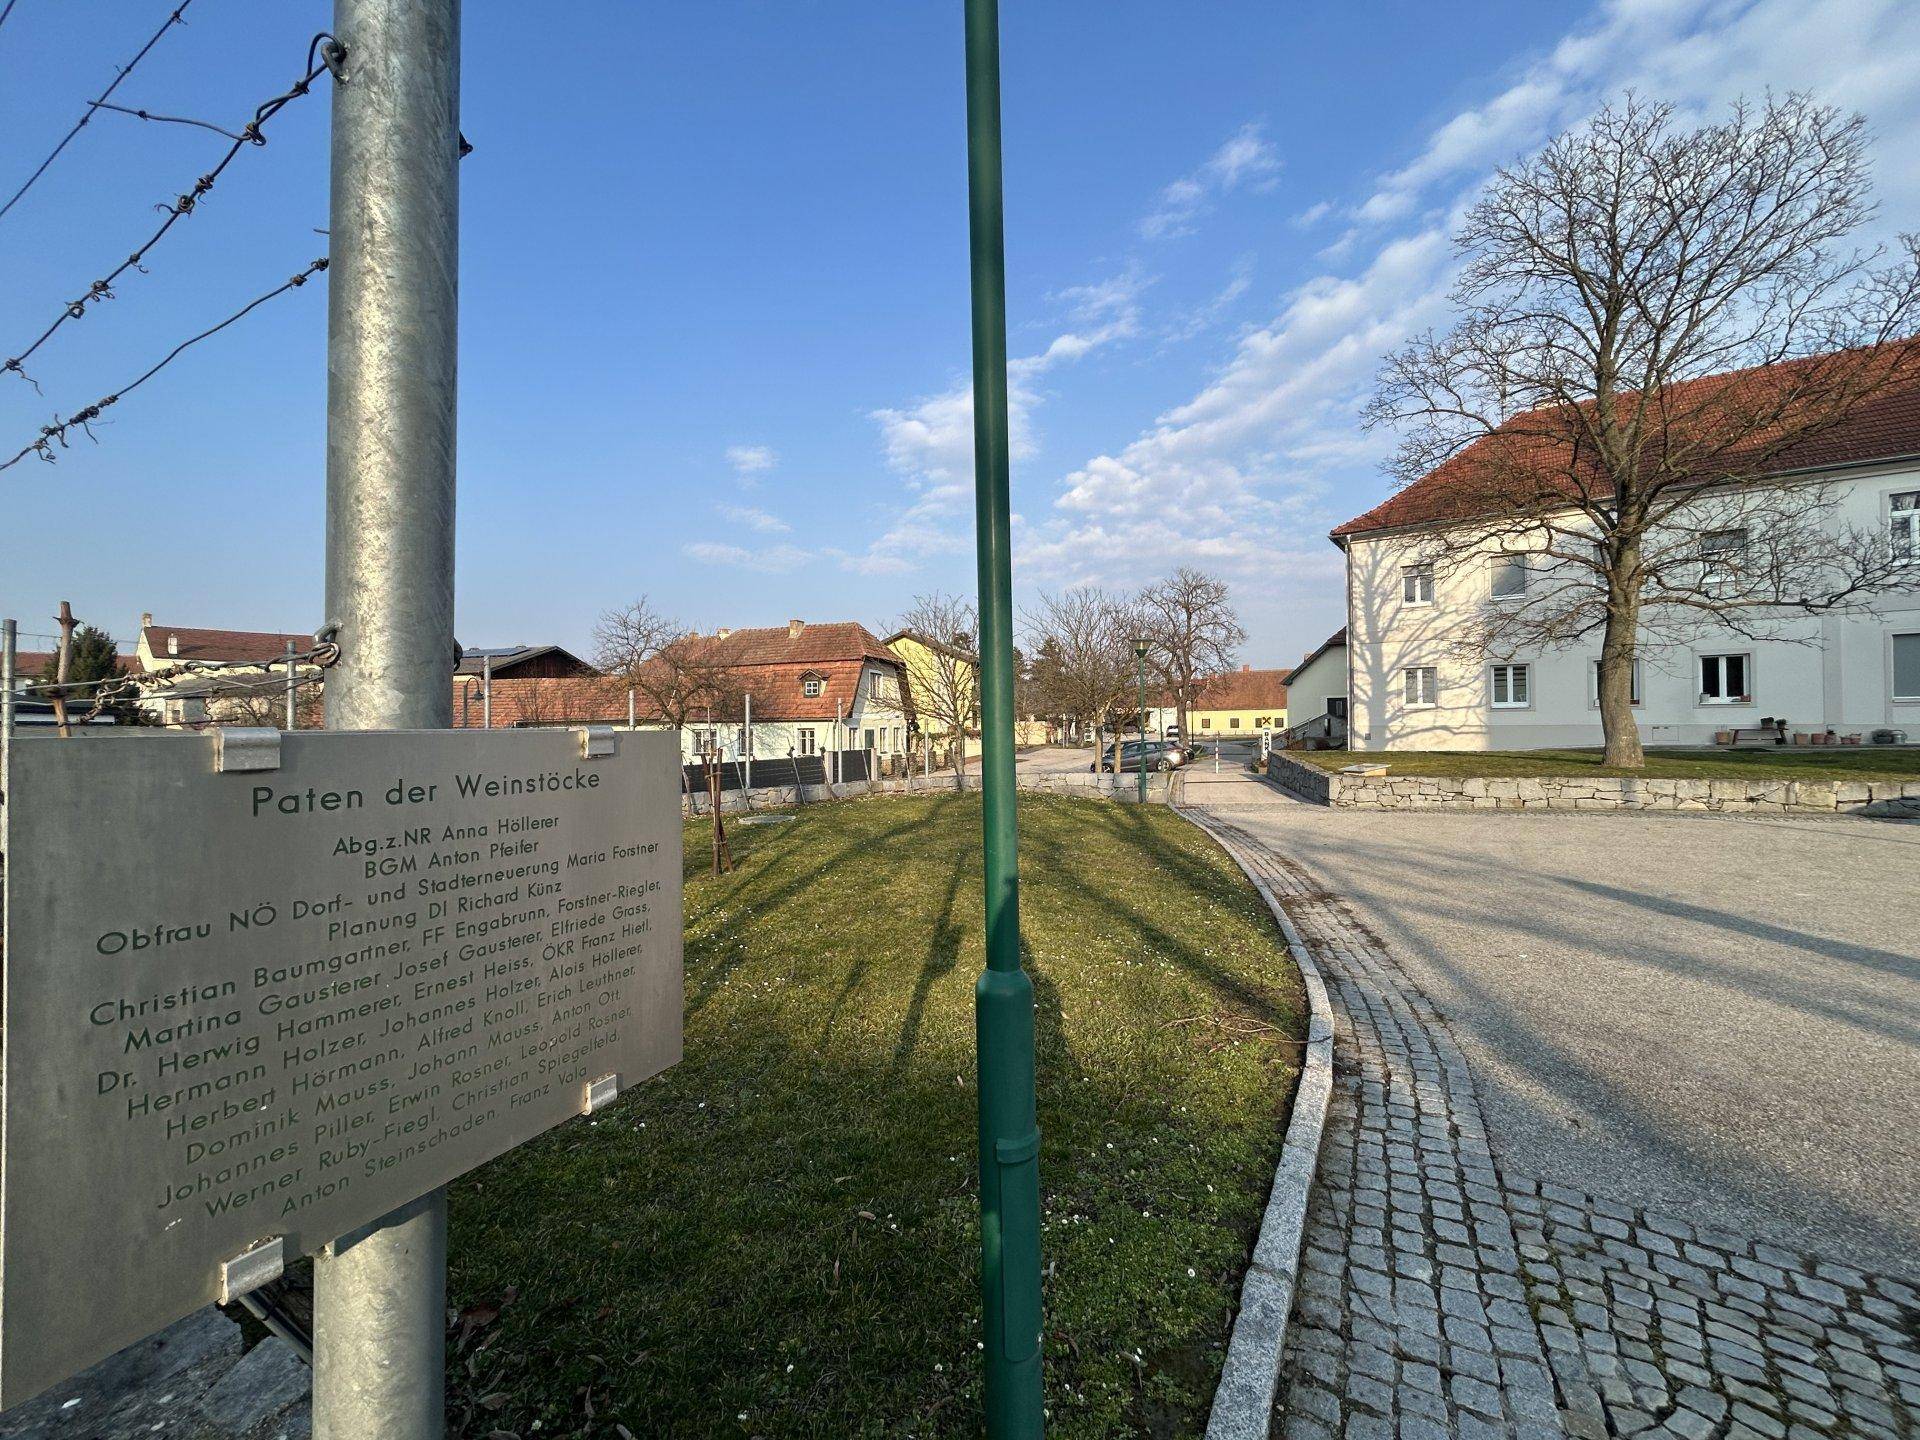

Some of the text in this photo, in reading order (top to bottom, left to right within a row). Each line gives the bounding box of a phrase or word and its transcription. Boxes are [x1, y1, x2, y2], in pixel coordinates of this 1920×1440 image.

[252, 768, 600, 817] Paten der Weinstöcke
[332, 816, 559, 856] Abg.z.NR Anna Höllerer
[365, 839, 539, 879] BGM Anton Pfeifer
[89, 980, 236, 1026] Christian
[254, 939, 411, 988] Baumgartner,
[423, 926, 445, 947] FF
[456, 907, 550, 939] Engabrunn,
[96, 842, 659, 955] Obfrau NÖ Dorf- und Stadterneuerung Maria Forstner
[329, 880, 562, 941] Planung DI Richard Künz
[124, 1009, 242, 1054] Martina
[258, 972, 381, 1015] Gausterer
[393, 950, 449, 980] Josef
[551, 912, 606, 938] Elfriede
[128, 1063, 266, 1121] Hermann
[379, 996, 476, 1037] Johannes
[549, 961, 585, 983] Alois
[158, 1035, 261, 1077] Herwig
[414, 970, 474, 1001] Ernest
[542, 939, 575, 961] ÖKR
[581, 931, 616, 951] Franz
[157, 1140, 299, 1210] Johannes
[389, 1083, 441, 1115] Erwin
[521, 1023, 581, 1060] Leopold
[166, 1087, 277, 1140] Herbert
[417, 1017, 473, 1052] Alfred
[537, 985, 572, 1009] Erich
[186, 1107, 301, 1166] Dominik
[407, 1044, 478, 1081] Johann
[552, 1001, 591, 1025] Anton
[204, 1167, 304, 1218] Werner
[452, 1069, 529, 1112] Christian
[280, 1175, 350, 1218] Anton
[510, 1086, 550, 1109] Franz
[558, 1064, 587, 1086] Vala
